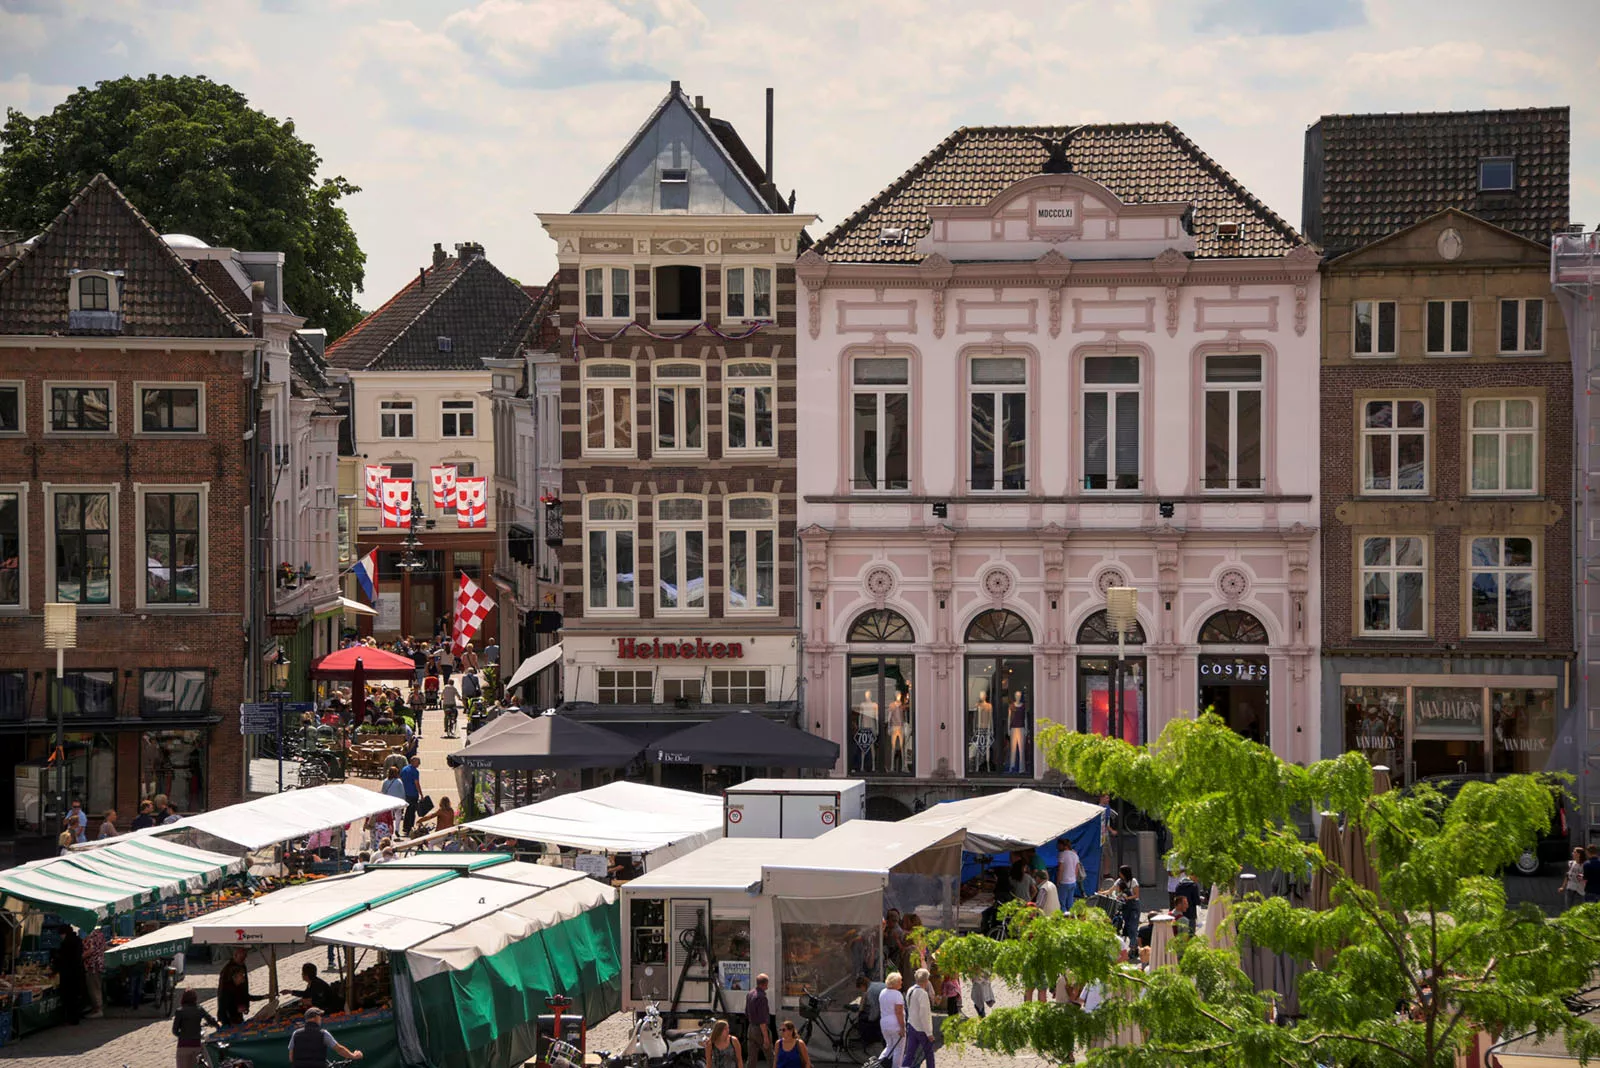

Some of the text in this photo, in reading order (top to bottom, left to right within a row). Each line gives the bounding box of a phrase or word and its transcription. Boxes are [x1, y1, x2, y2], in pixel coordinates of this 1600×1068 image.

[1038, 209, 1073, 218] MDCCCLXI
[562, 239, 793, 253] A E O U
[617, 637, 744, 660] Heineken
[1200, 664, 1268, 675] COSTES
[1419, 700, 1442, 719] VAN
[1355, 735, 1370, 749] VAN
[1503, 738, 1519, 751] VAN
[122, 941, 186, 961] Fruithandel
